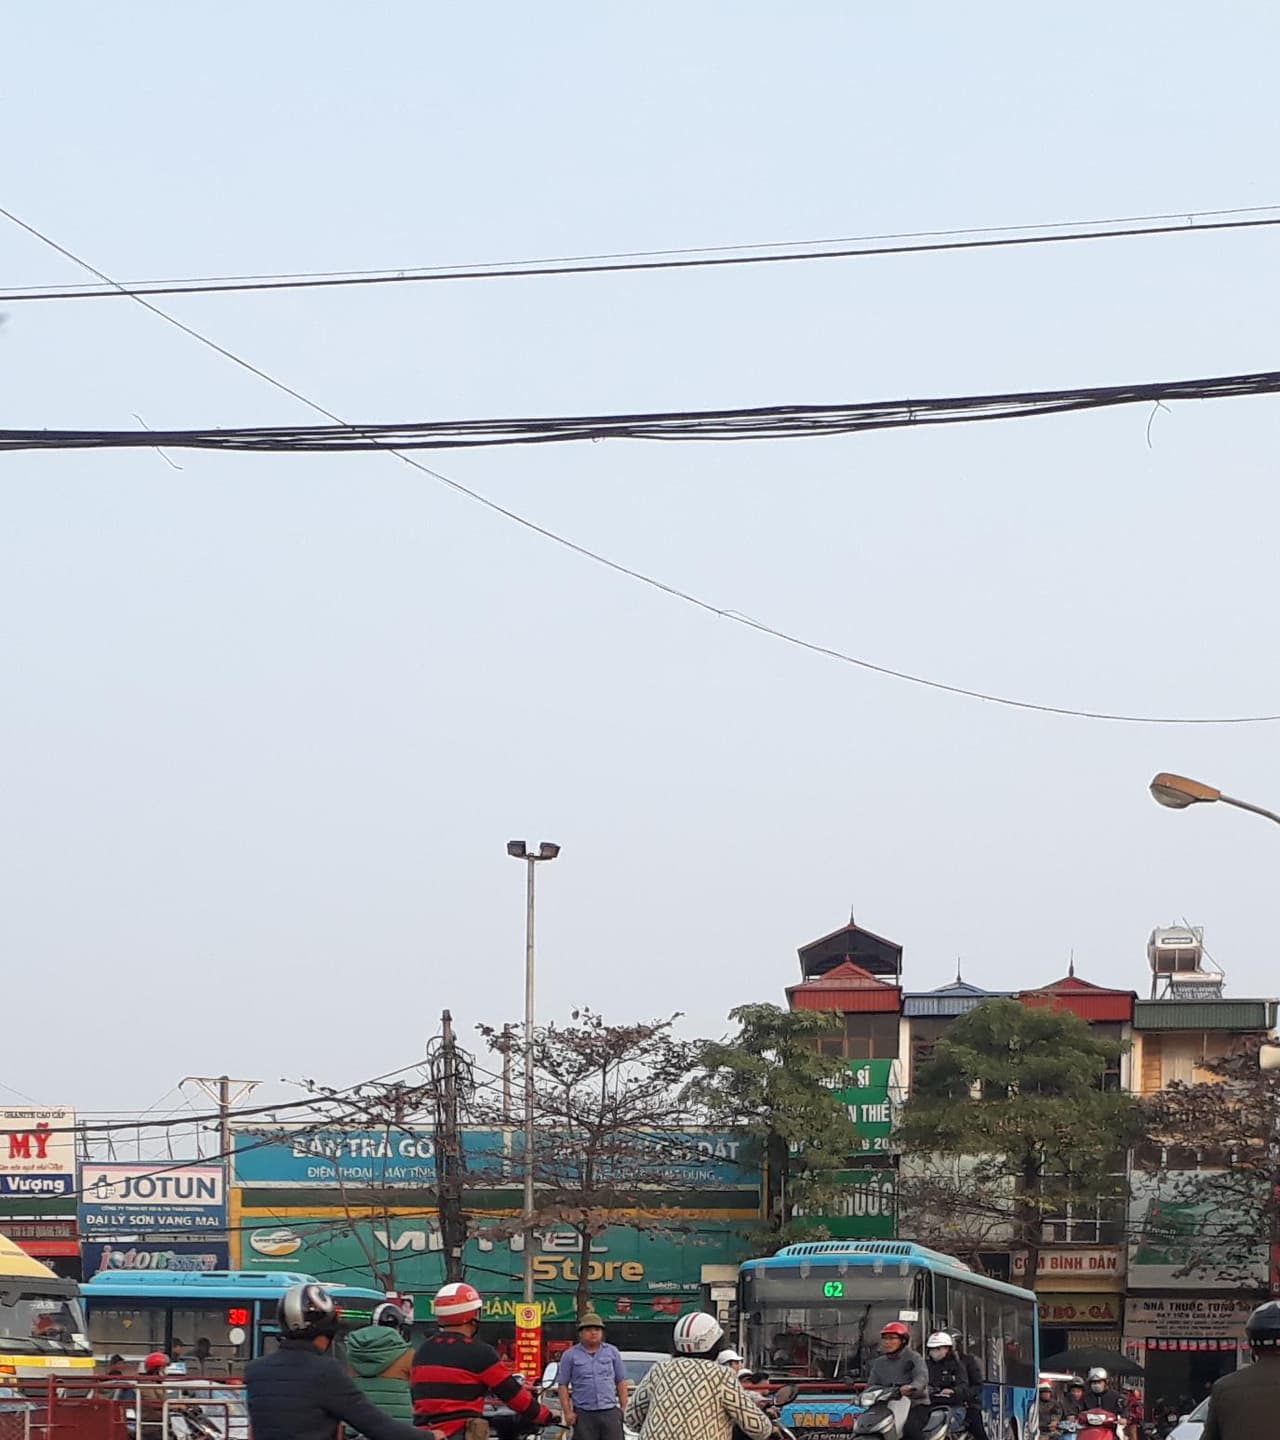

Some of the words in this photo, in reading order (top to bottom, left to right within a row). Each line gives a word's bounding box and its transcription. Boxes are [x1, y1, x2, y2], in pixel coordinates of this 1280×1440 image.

[8, 1122, 52, 1160] MỸ
[399, 1135, 434, 1158] GÓ
[6, 1176, 65, 1193] Vượng
[120, 1176, 216, 1198] JOTUN
[374, 1230, 608, 1252] VIEL
[531, 1255, 644, 1282] Store
[1050, 1256, 1083, 1270] BÌNH
[1088, 1254, 1117, 1270] DÂN
[823, 1281, 844, 1298] 62
[481, 1296, 517, 1320] HẬN
